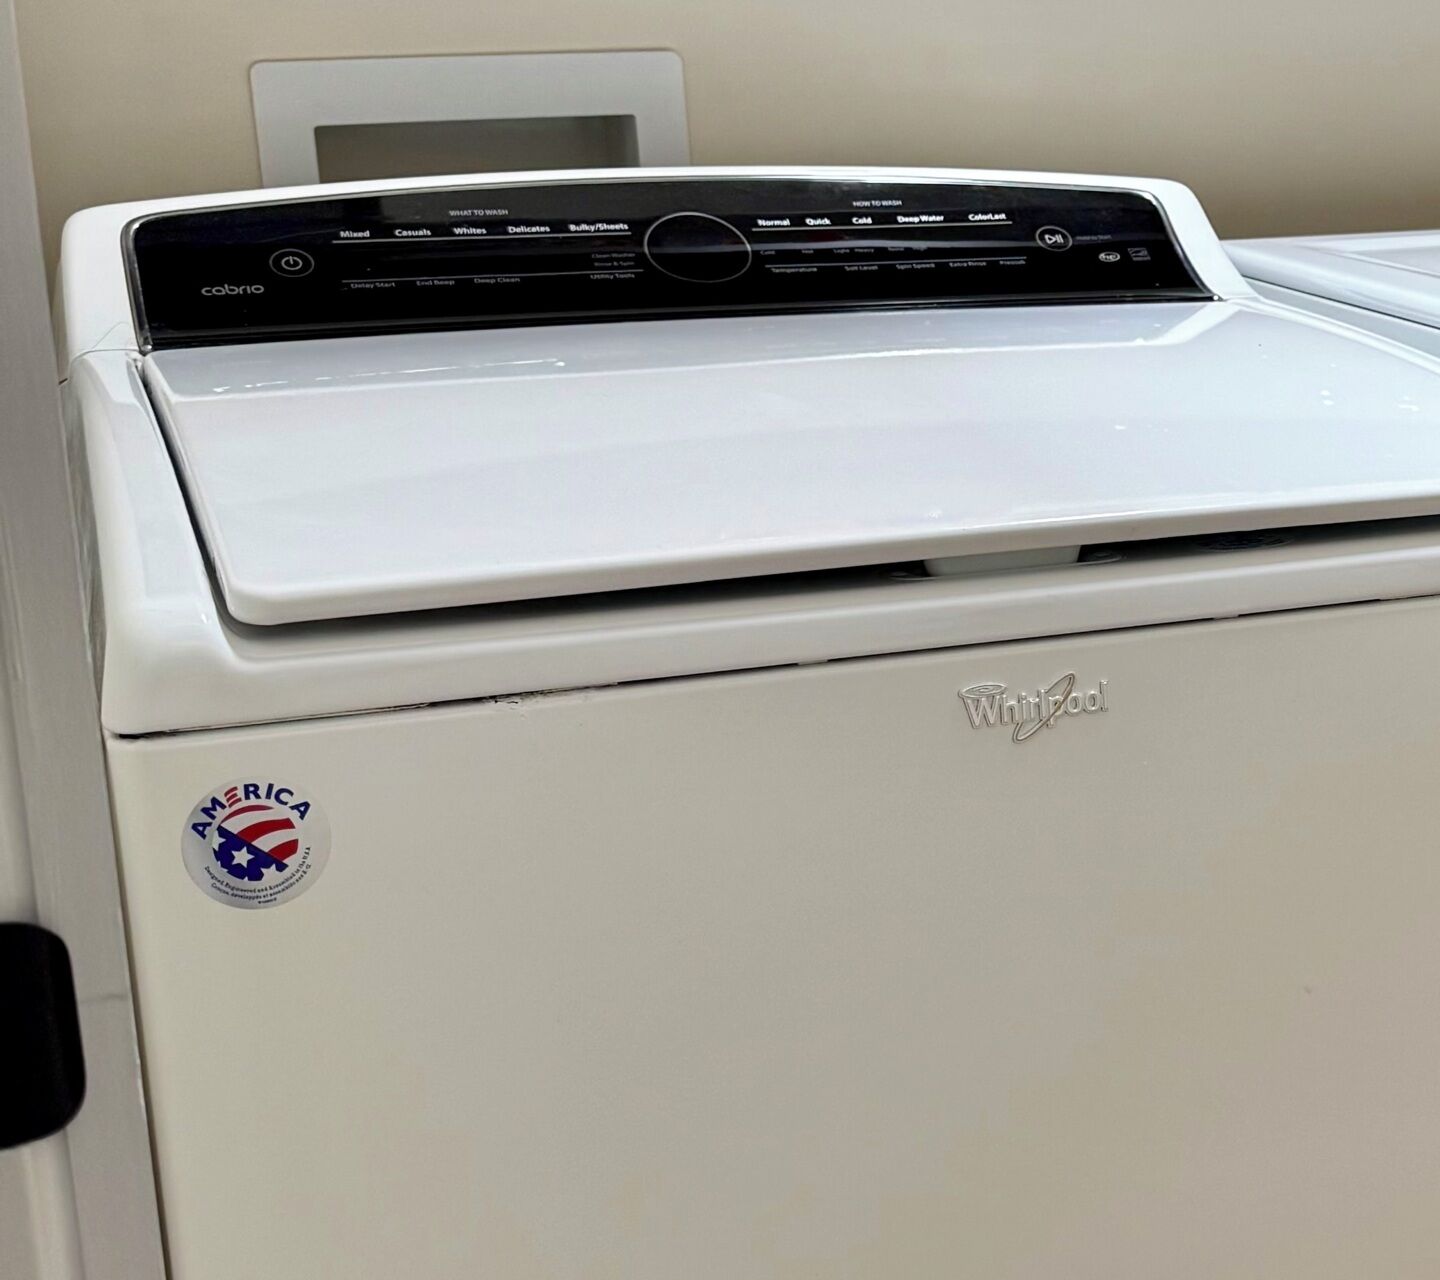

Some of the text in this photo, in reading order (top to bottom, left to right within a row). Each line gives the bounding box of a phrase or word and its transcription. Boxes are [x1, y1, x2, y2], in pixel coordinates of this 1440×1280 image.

[757, 218, 791, 227] Normal
[805, 218, 832, 226] Quick
[897, 215, 919, 223] Deep
[394, 228, 432, 237] Casuals
[453, 226, 487, 235] Whites
[507, 225, 550, 234] Delicates
[567, 223, 629, 233] Bulky/Sheets
[340, 230, 370, 238] Mixed
[201, 284, 265, 296] cabrio
[958, 675, 1110, 732] Whirlpool
[190, 782, 312, 841] AMERICA
